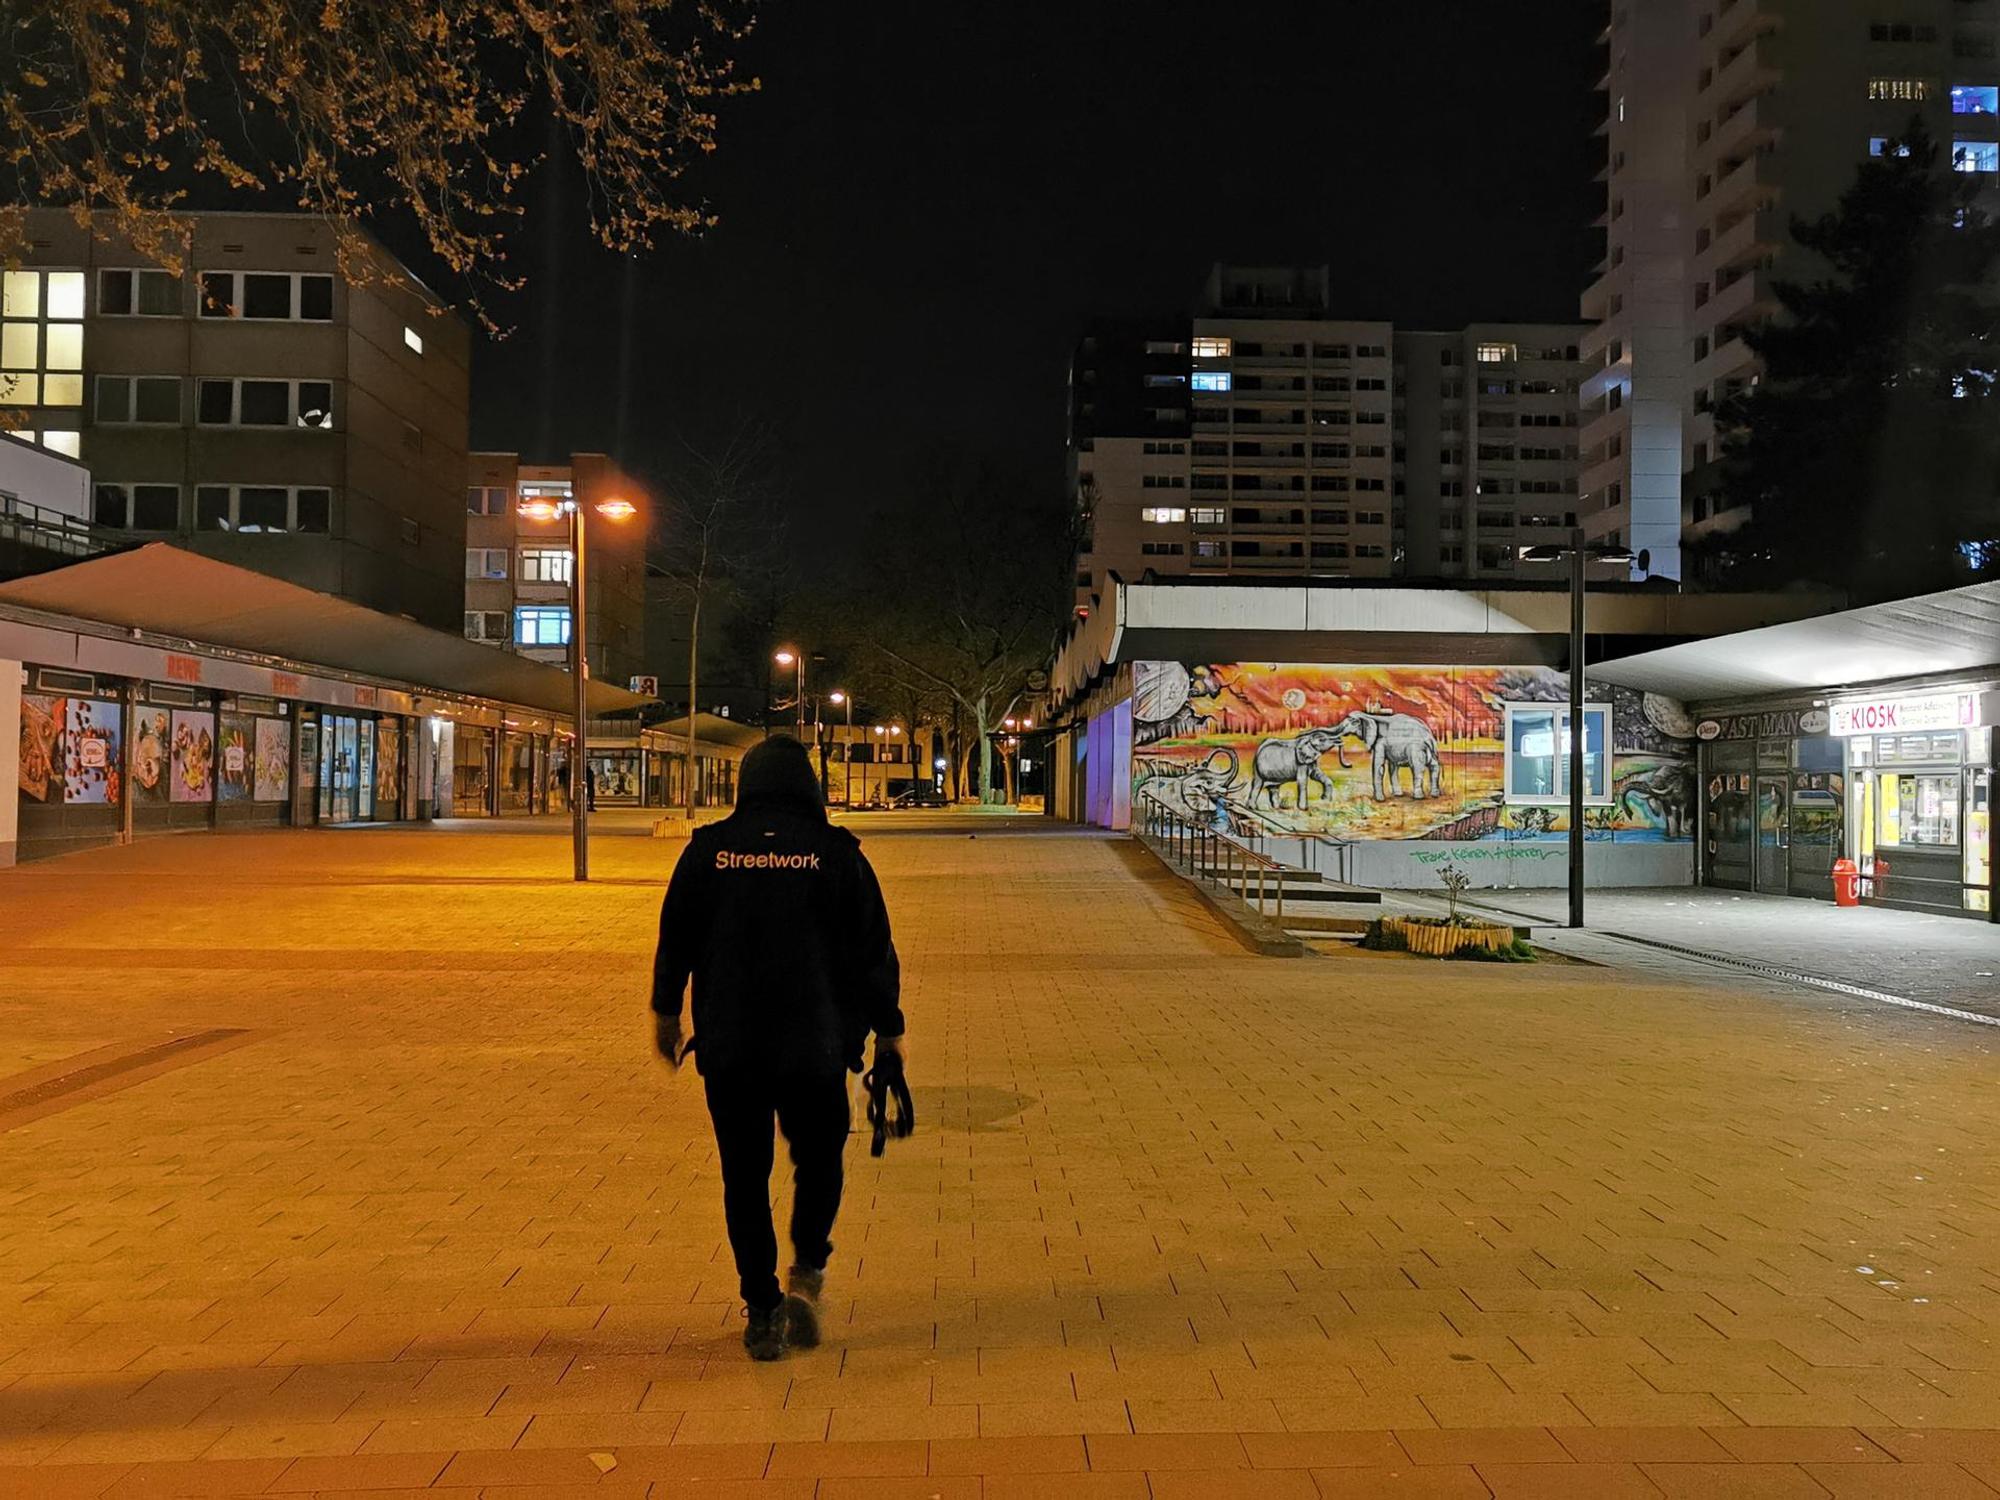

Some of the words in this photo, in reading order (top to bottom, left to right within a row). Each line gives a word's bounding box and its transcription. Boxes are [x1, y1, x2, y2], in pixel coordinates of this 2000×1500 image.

[1719, 717, 1758, 739] FAST
[1762, 711, 1799, 737] MAN
[1851, 704, 1897, 729] KIOSK
[715, 850, 820, 870] Streetwork
